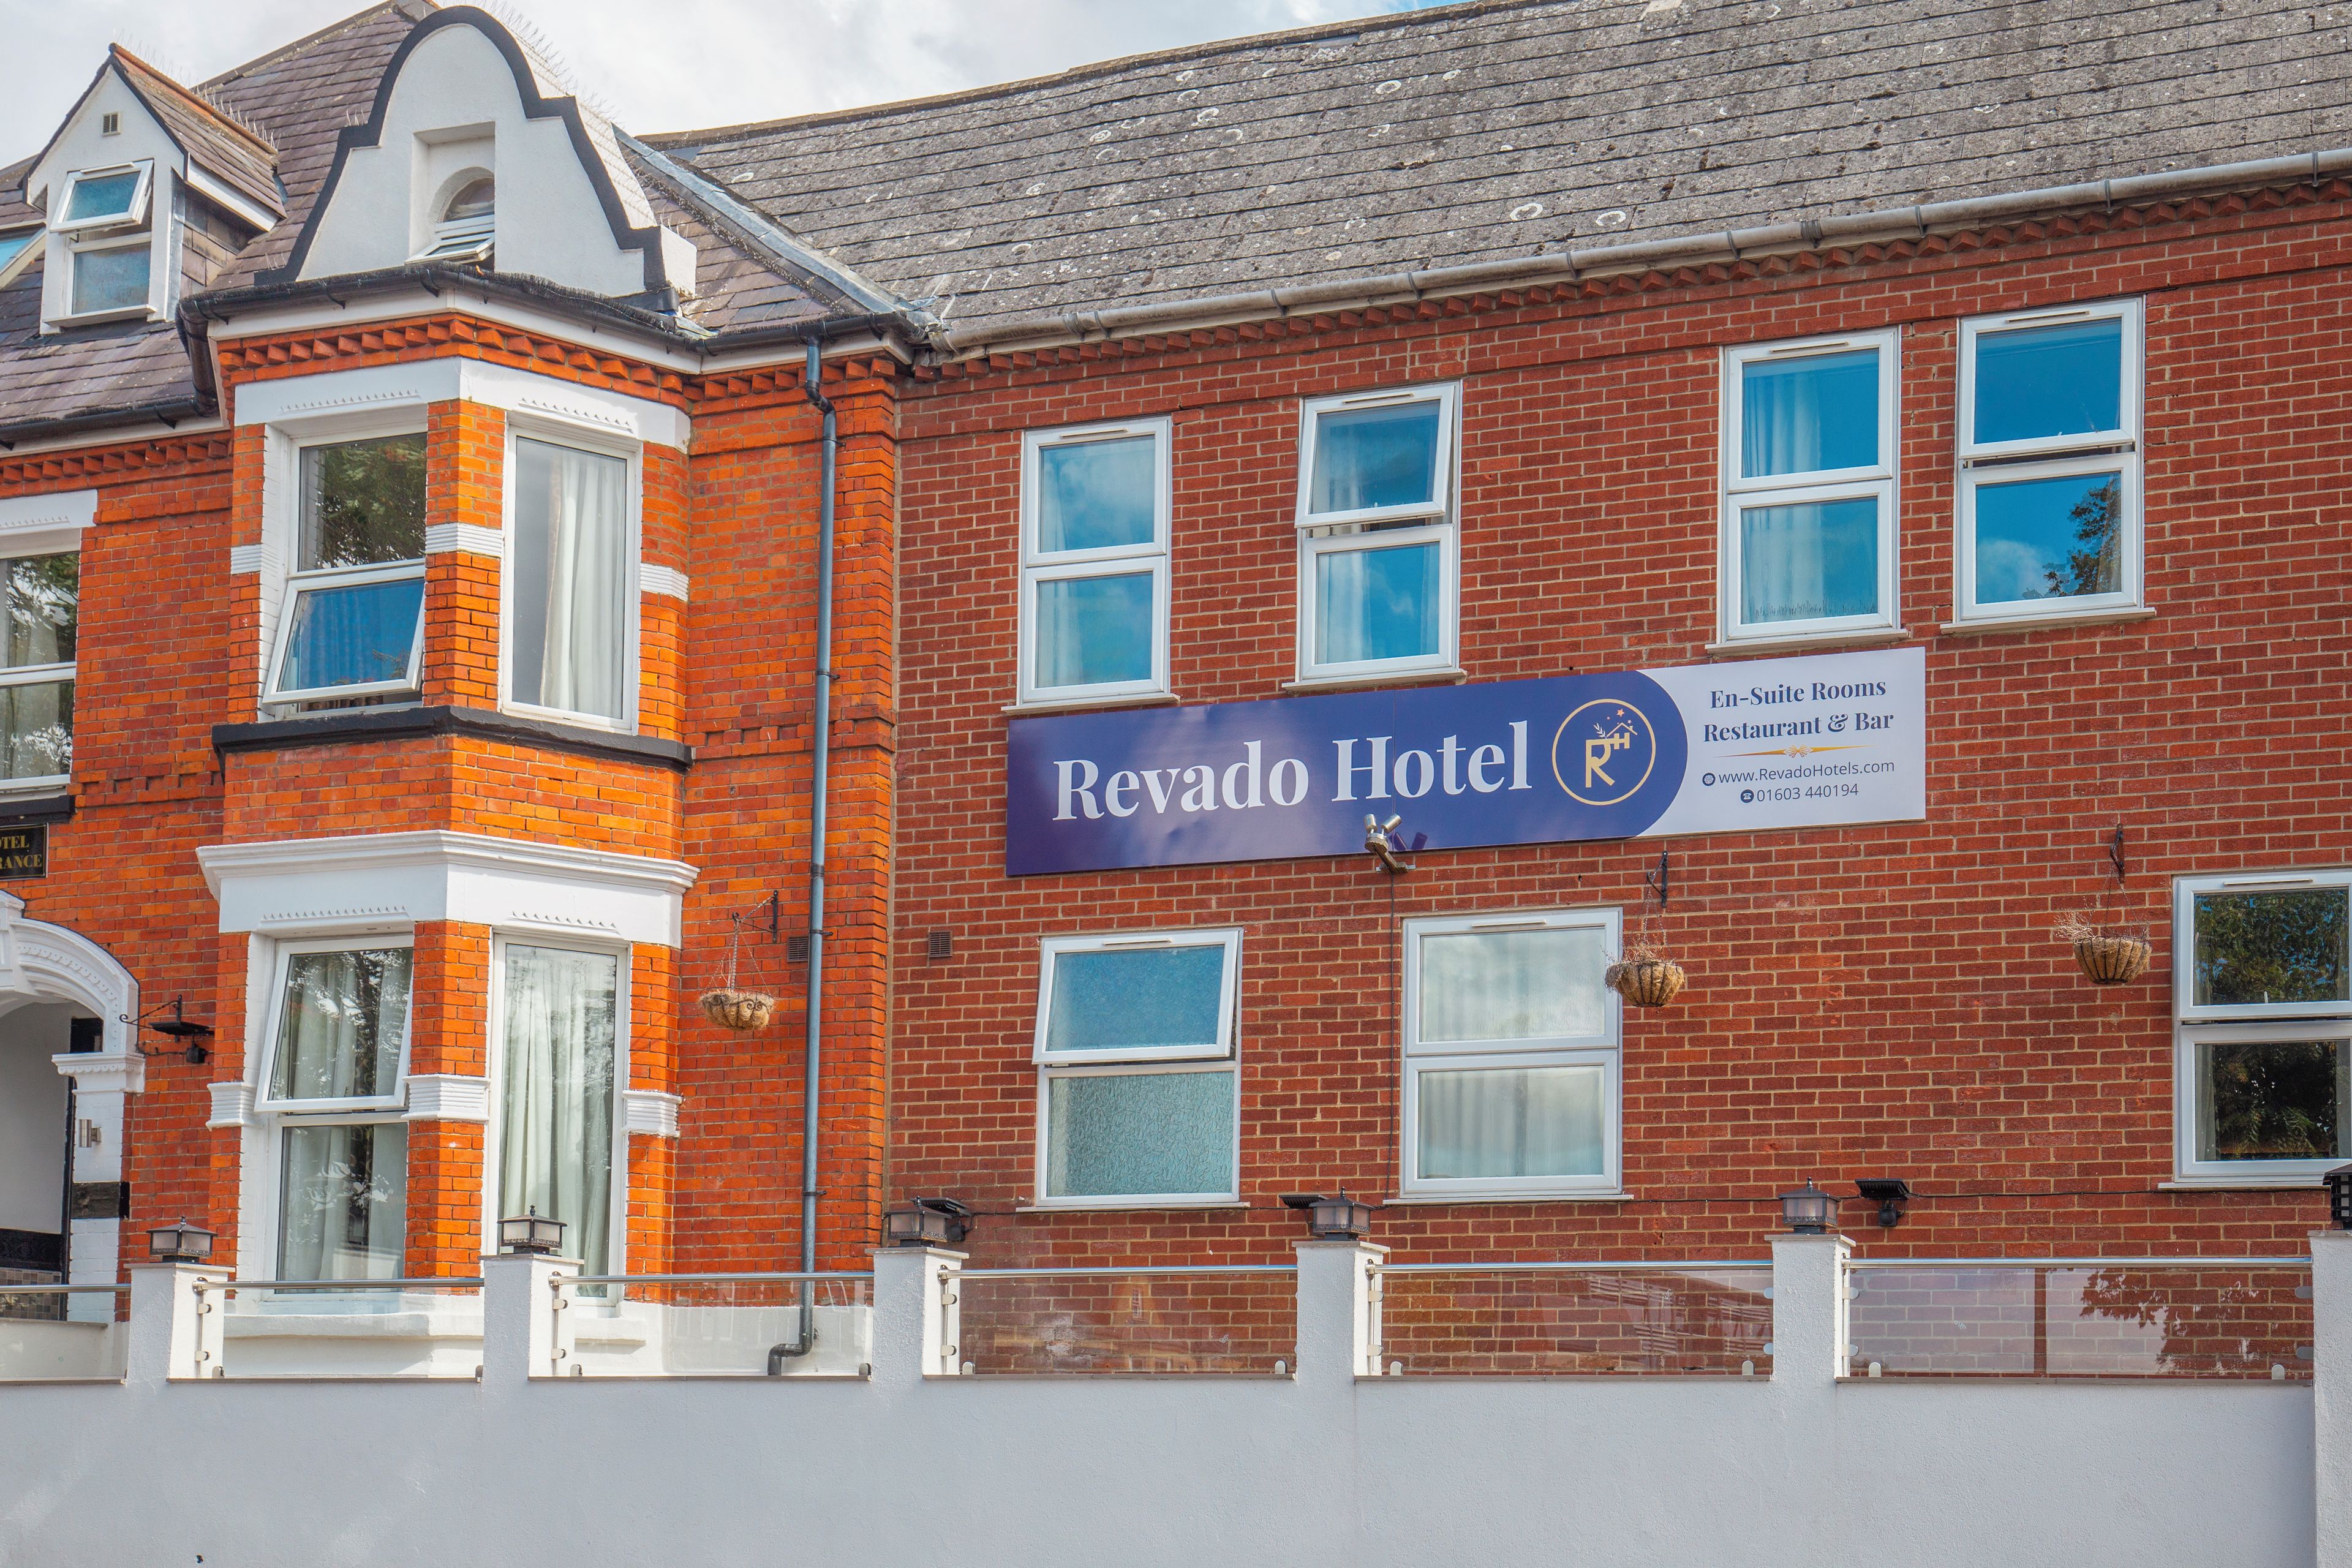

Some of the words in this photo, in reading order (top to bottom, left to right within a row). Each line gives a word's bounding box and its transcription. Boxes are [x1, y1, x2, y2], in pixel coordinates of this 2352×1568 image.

[1710, 684, 1804, 709] En-Suite
[1811, 682, 1886, 701] Rooms
[1703, 717, 1822, 742] Restaurant
[1828, 714, 1849, 733] &
[1855, 712, 1894, 731] Bar
[1052, 740, 1309, 821] Revado
[1332, 720, 1532, 802] Hotel
[1719, 761, 1895, 784] www.RevadoHotels.com
[1757, 788, 1801, 802] 01603
[1804, 783, 1859, 799] 440194
[0, 835, 29, 850] TEL
